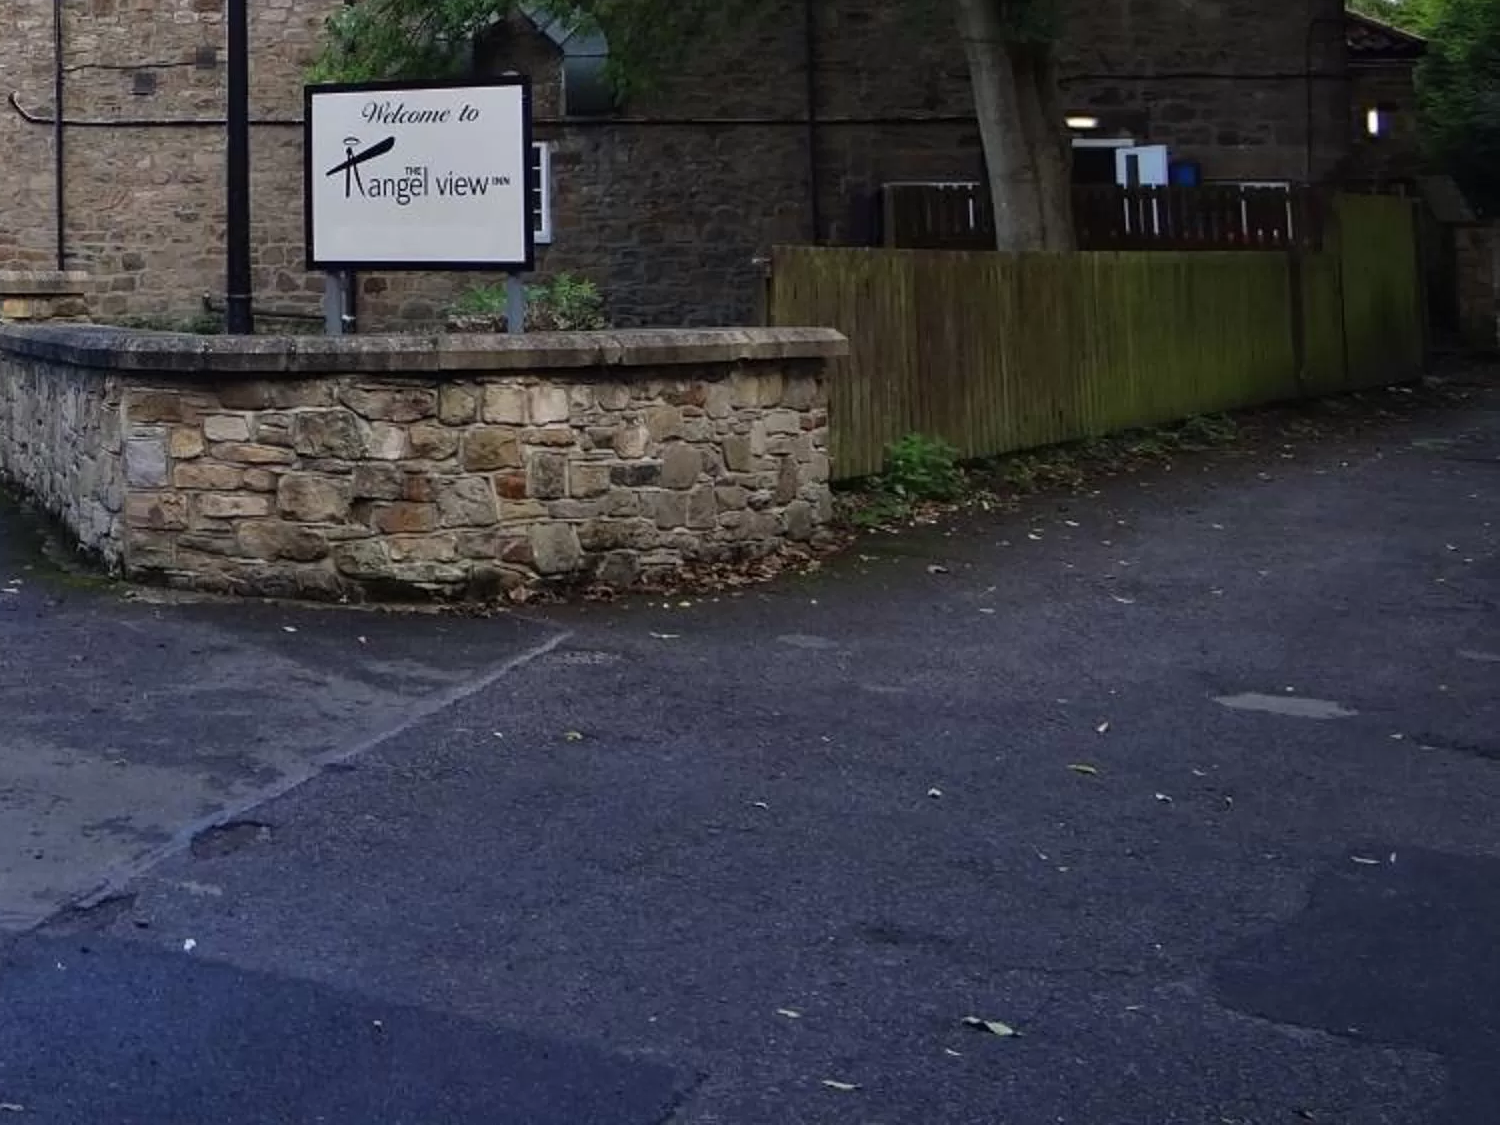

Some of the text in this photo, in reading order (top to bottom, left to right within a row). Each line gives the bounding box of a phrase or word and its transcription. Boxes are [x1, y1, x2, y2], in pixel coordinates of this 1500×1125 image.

[361, 101, 480, 124] Welcome to
[405, 166, 422, 176] THE
[368, 166, 511, 205] angel view INN
